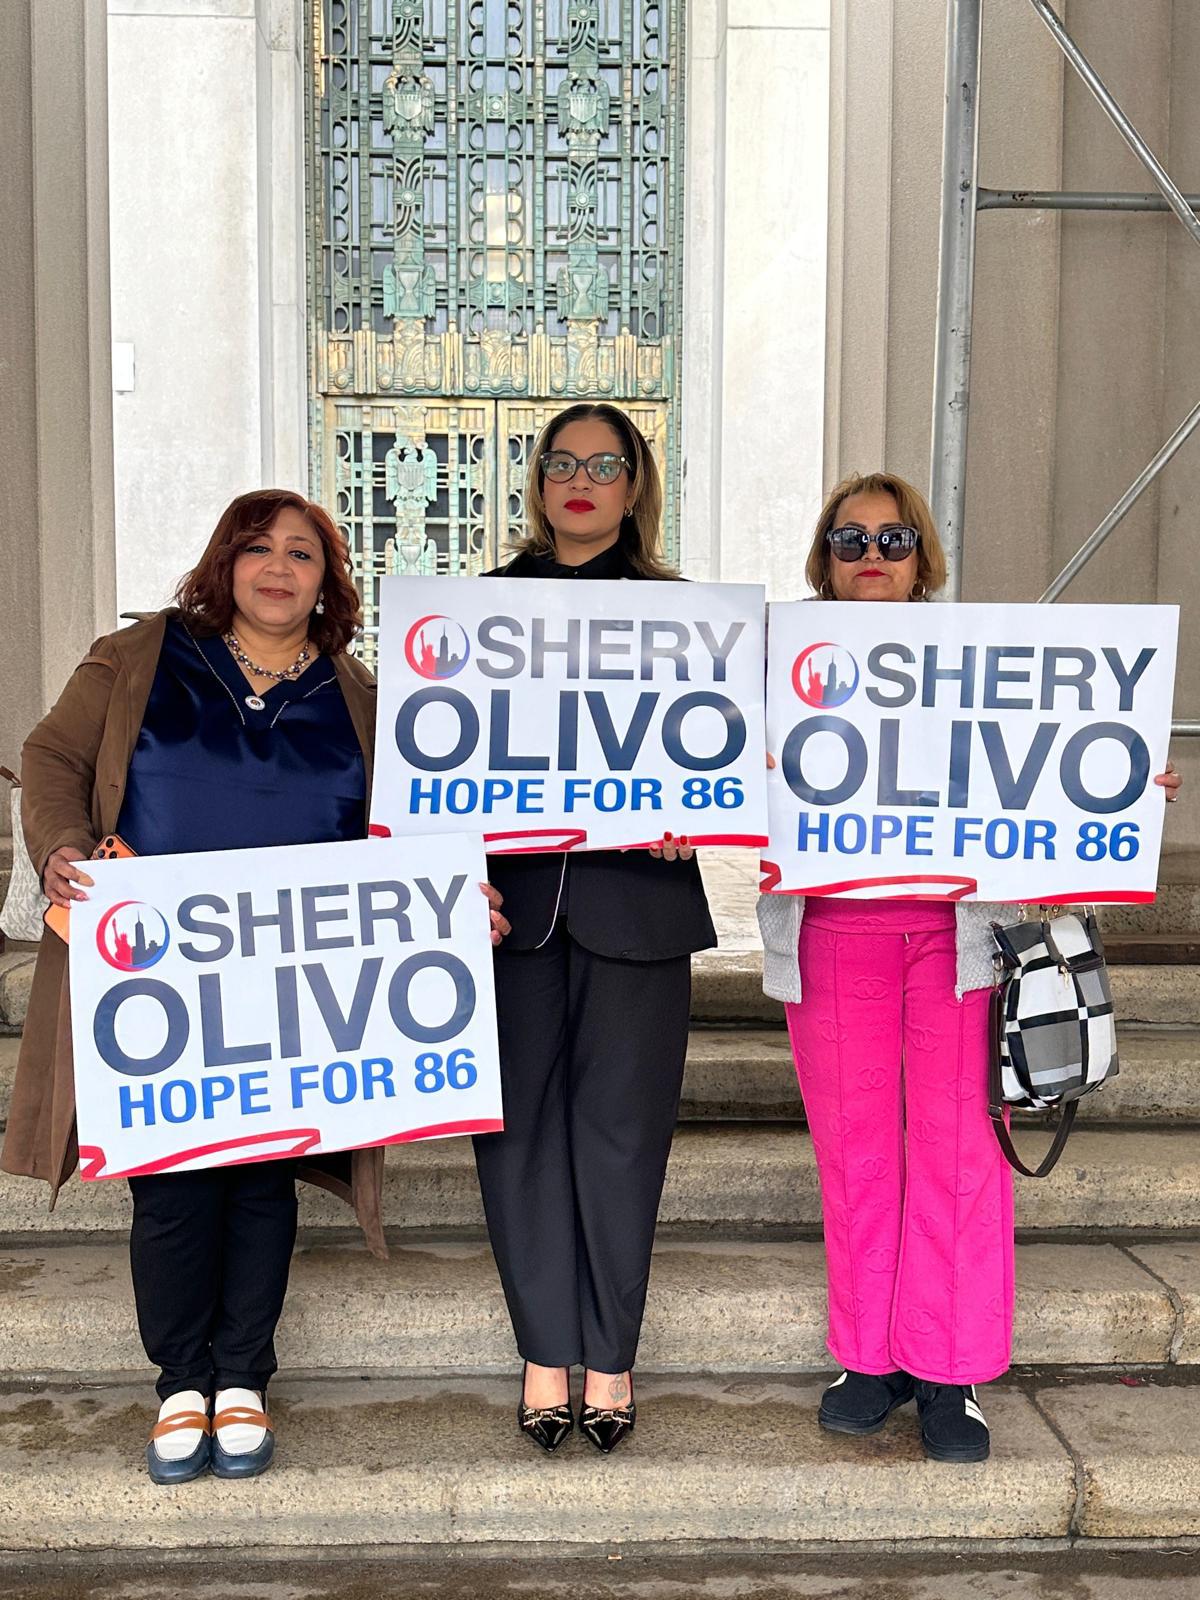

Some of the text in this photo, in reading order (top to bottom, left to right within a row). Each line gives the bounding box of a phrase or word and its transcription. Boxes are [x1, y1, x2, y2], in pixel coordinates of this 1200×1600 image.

[476, 615, 746, 682] SHERY
[865, 642, 1157, 712] SHERY
[395, 686, 747, 772] OLIVO
[781, 715, 1151, 814] OLIVO
[409, 776, 744, 814] HOPE FOR 86
[797, 812, 1139, 861] HOPE FOR 86
[177, 874, 468, 962] SHERY
[93, 950, 476, 1076] OLIVO
[119, 1048, 478, 1128] HOPE FOR 86
